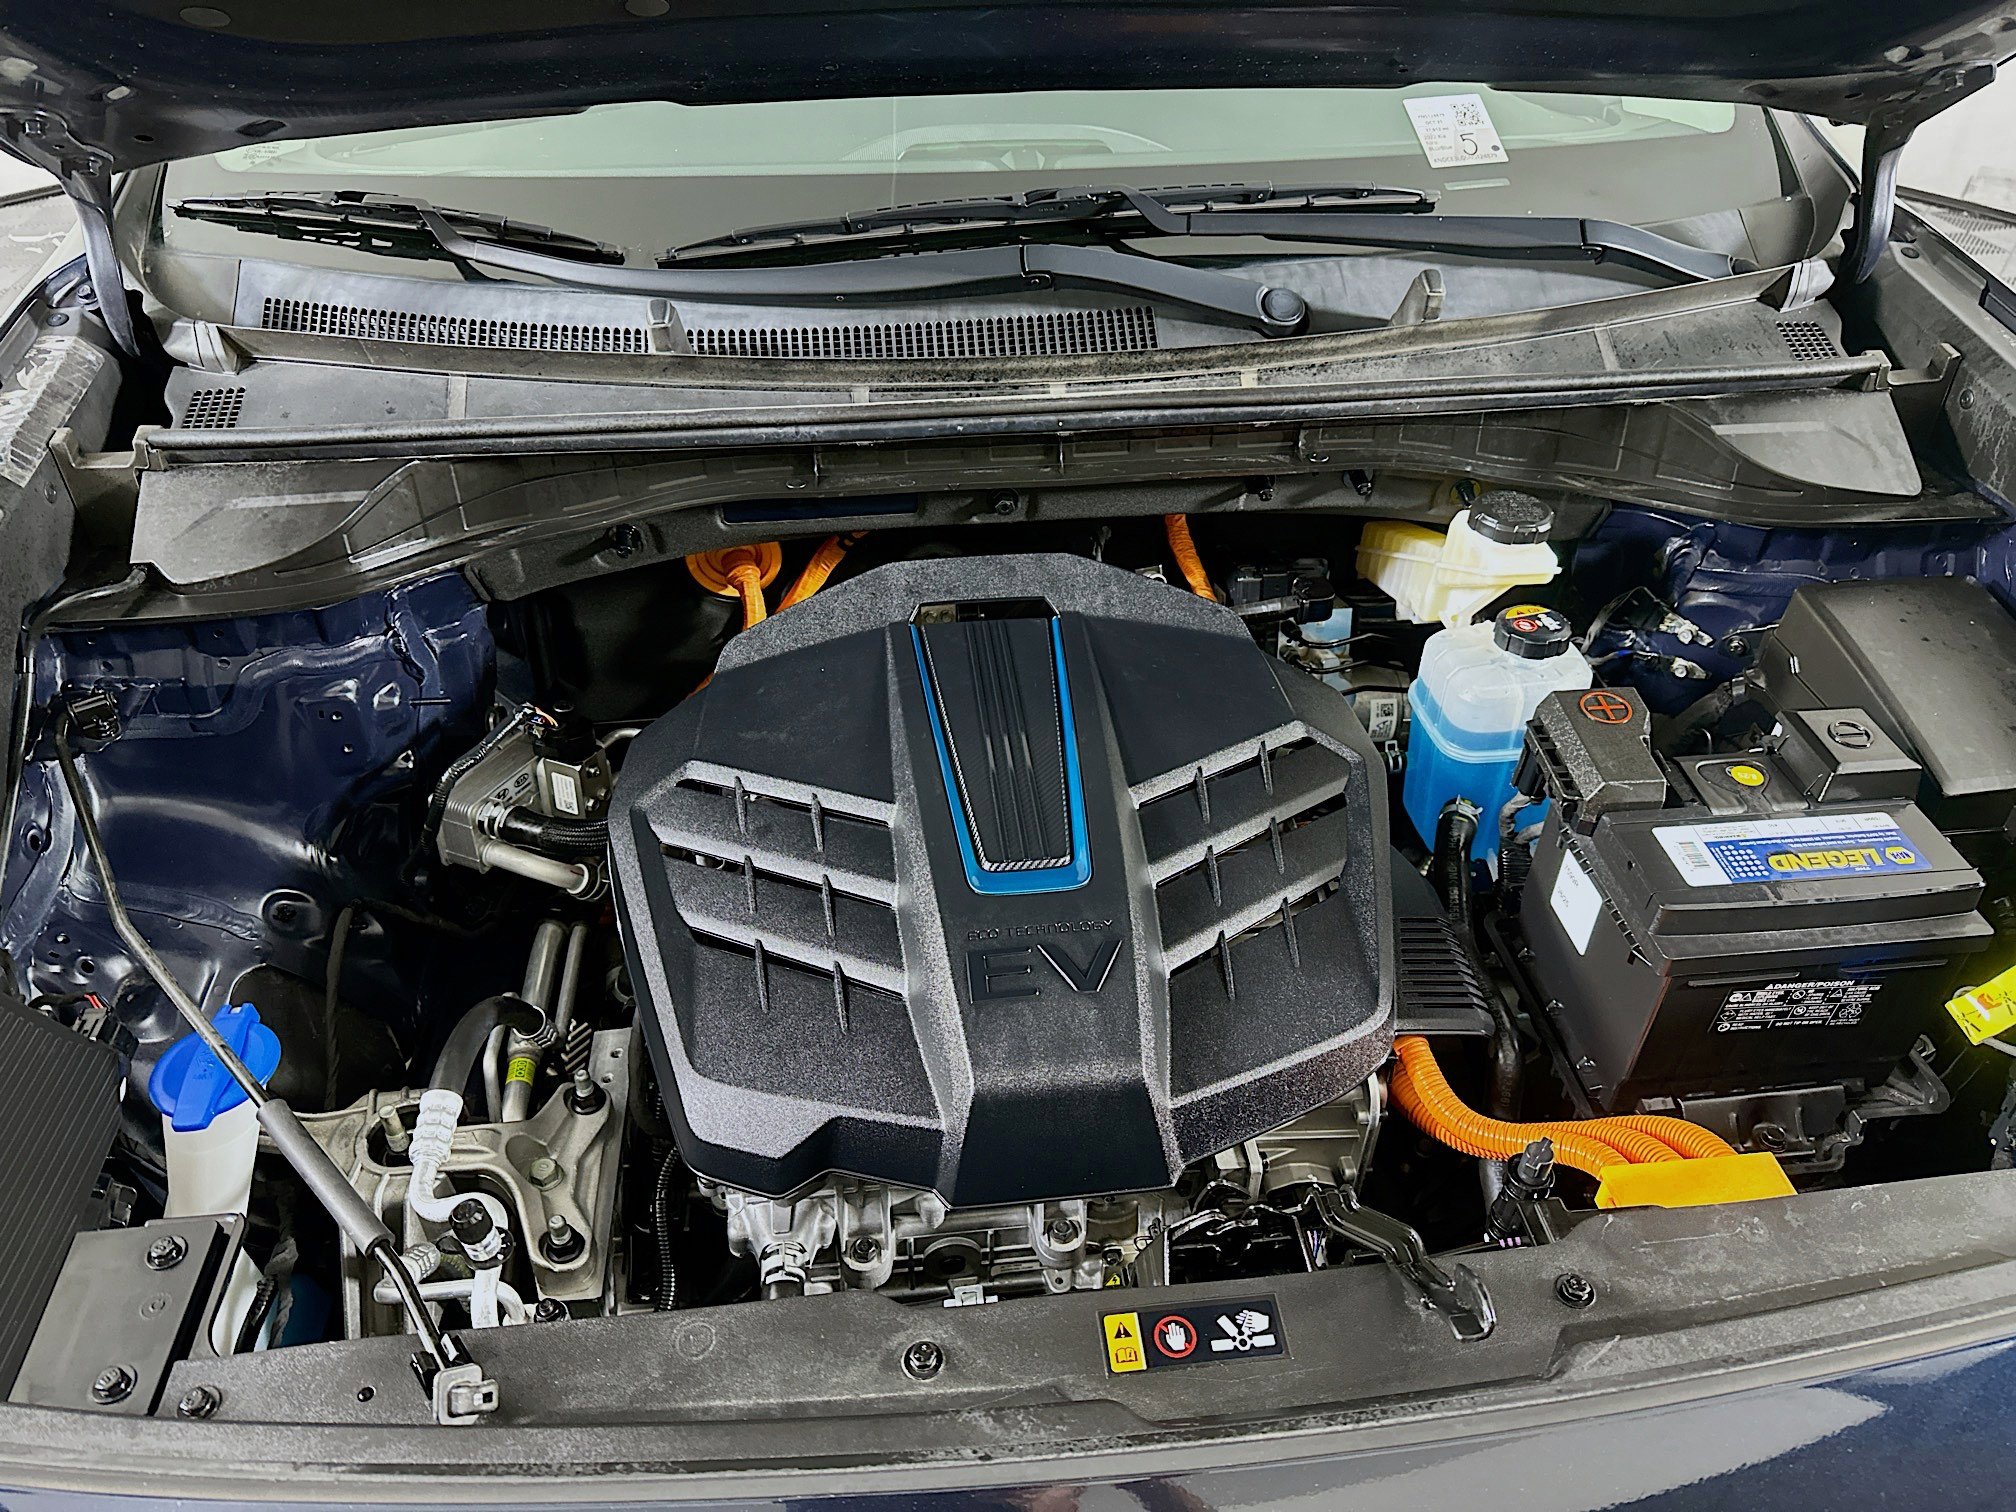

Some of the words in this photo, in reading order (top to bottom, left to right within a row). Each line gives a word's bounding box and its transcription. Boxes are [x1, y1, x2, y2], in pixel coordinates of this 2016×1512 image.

[1459, 133, 1478, 156] 5
[1768, 847, 1884, 872] LEGEND
[1889, 850, 1912, 860] NAPA
[967, 928, 999, 941] ECO
[1008, 919, 1113, 938] TECHNOLOGY
[966, 939, 1126, 1004] EV
[1773, 980, 1856, 990] DANGER/POISON
